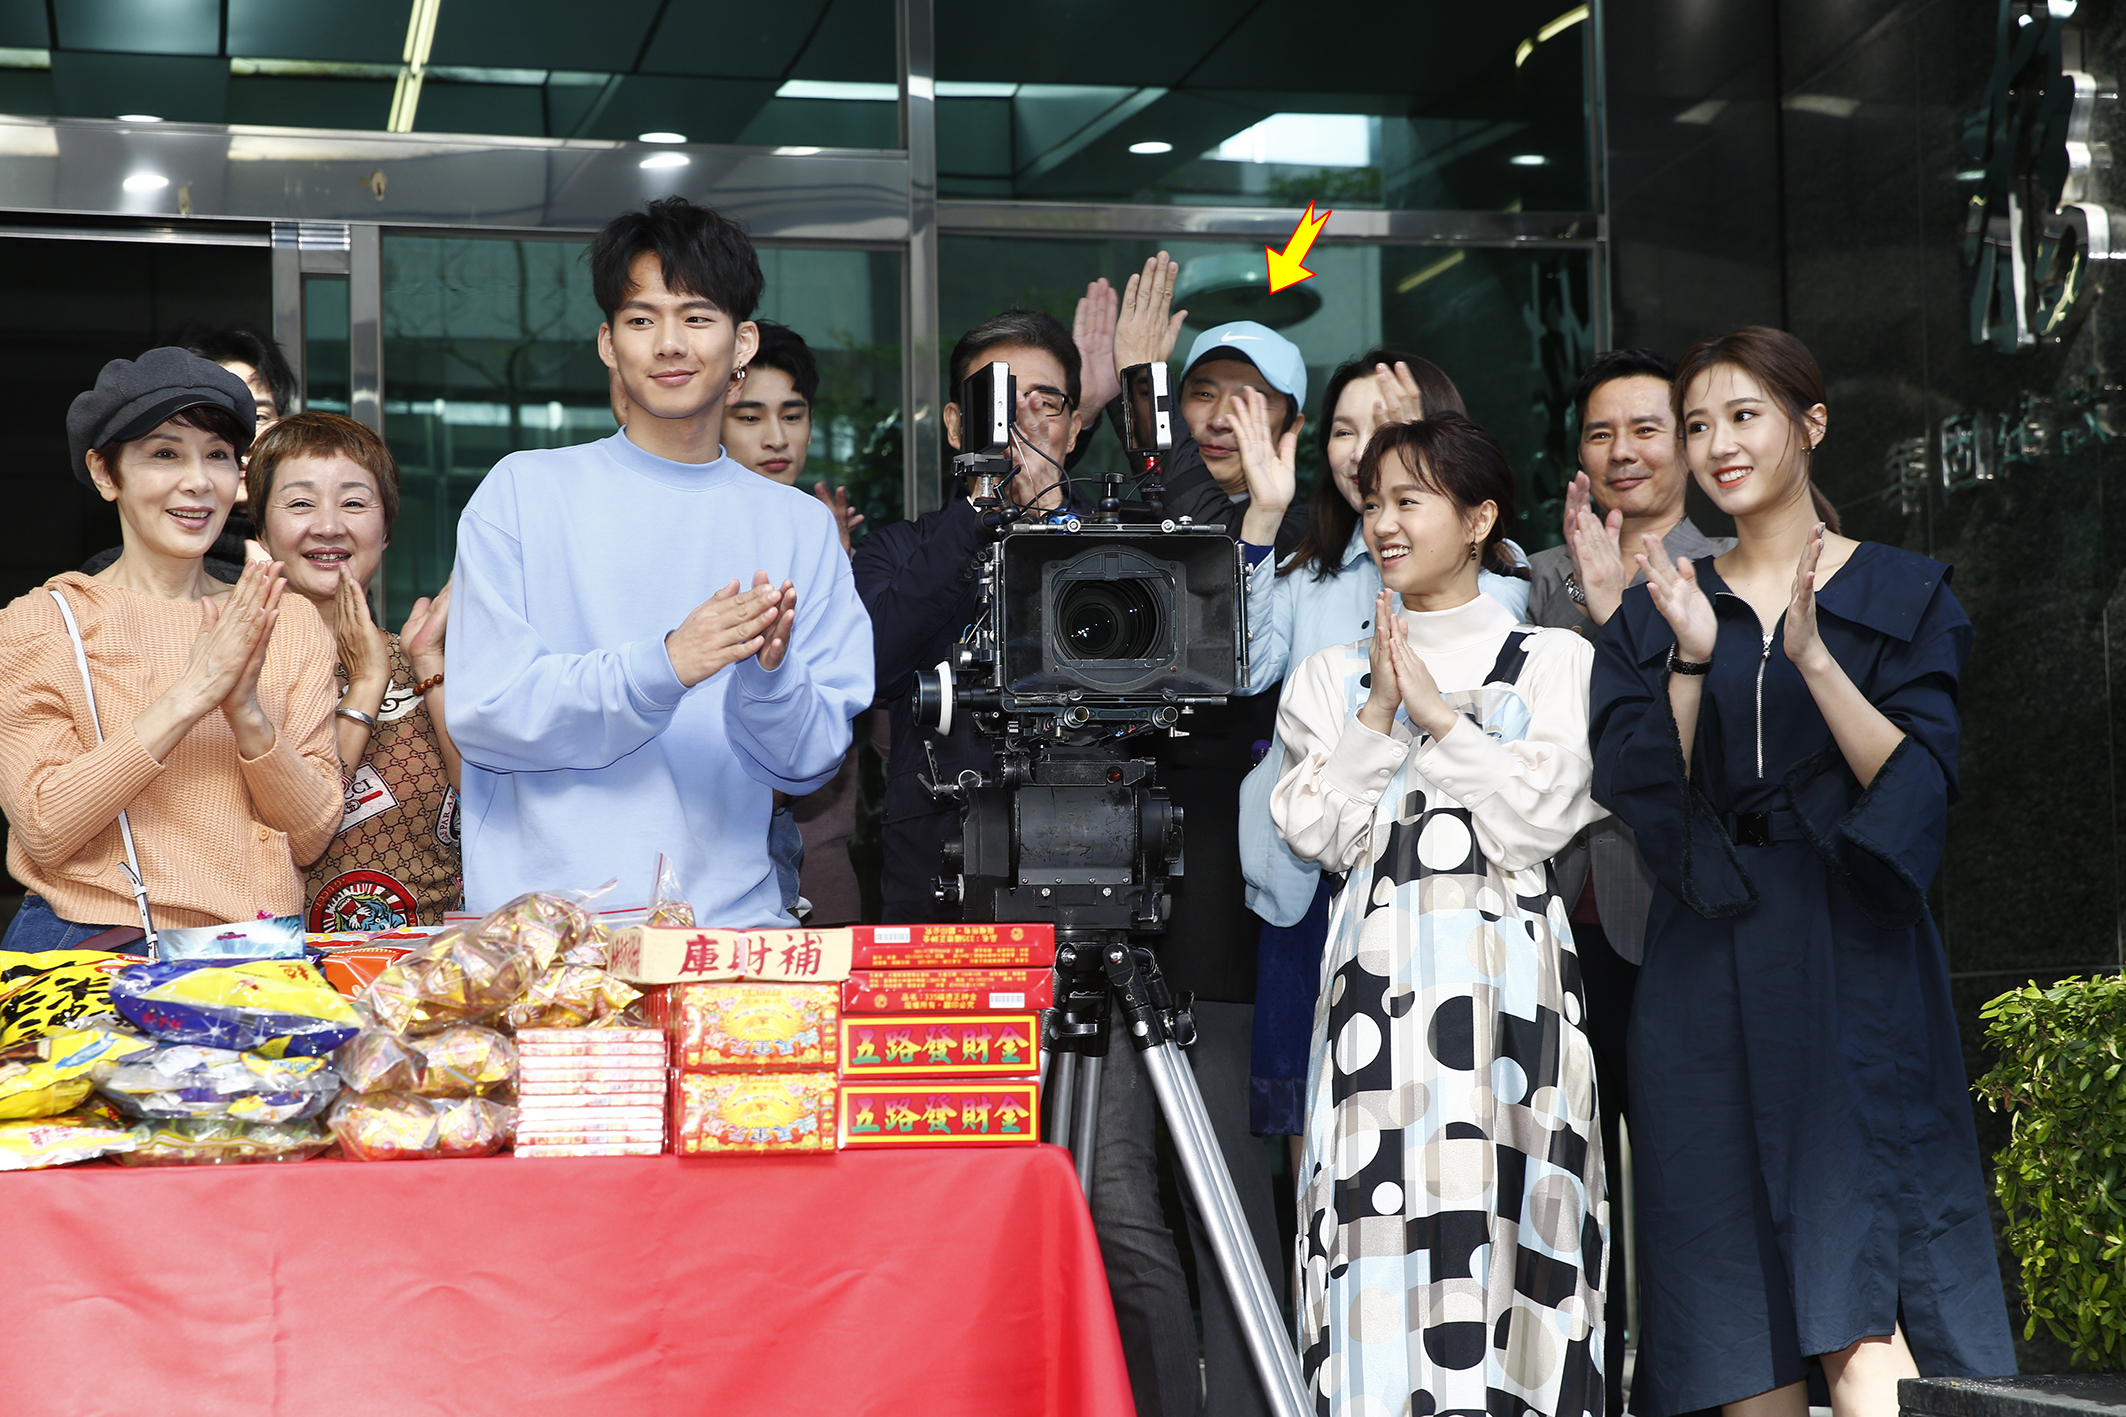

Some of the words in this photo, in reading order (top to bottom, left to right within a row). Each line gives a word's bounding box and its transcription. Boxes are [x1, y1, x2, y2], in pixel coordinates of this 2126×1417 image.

[851, 1024, 1030, 1064] 五路發財金
[851, 1093, 1030, 1134] 五路發財金
